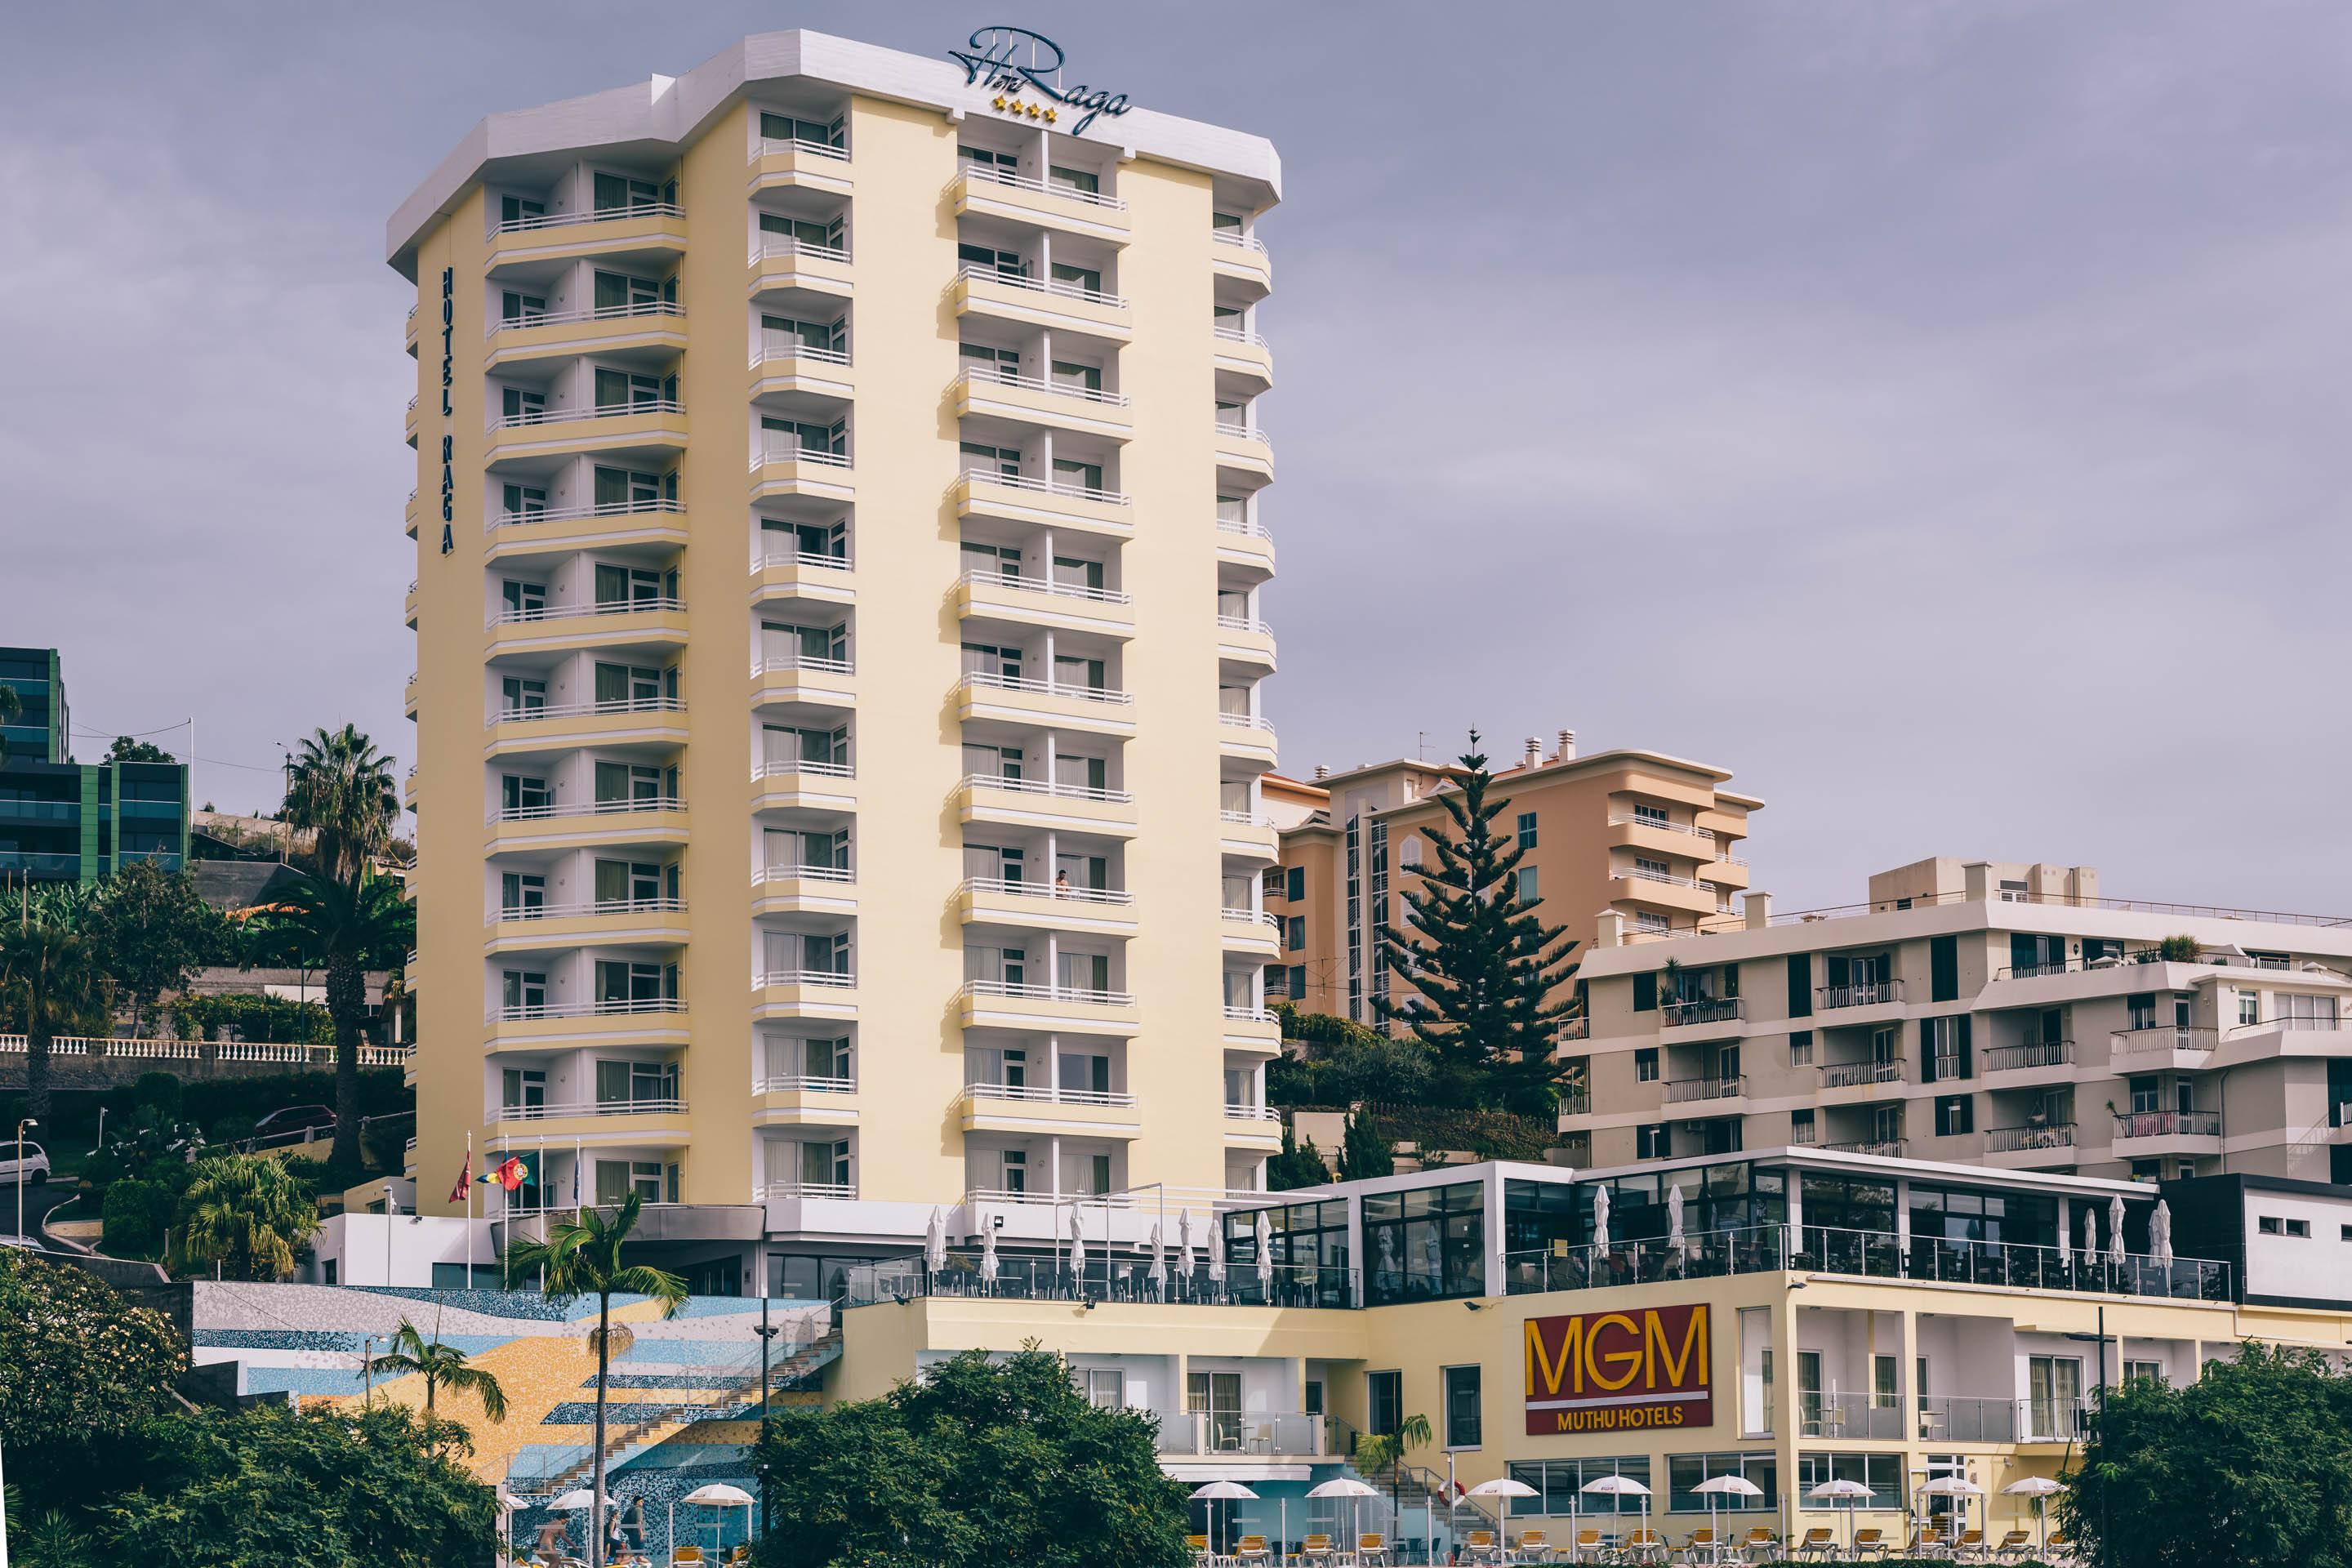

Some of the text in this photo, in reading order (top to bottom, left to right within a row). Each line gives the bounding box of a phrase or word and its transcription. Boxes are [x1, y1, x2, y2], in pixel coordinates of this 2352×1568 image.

[969, 26, 1132, 136] Raga
[441, 267, 454, 555] HOTEL RAGA
[1526, 1306, 1708, 1396] MGM
[1557, 1405, 1684, 1432] MUTHU HOTELS
